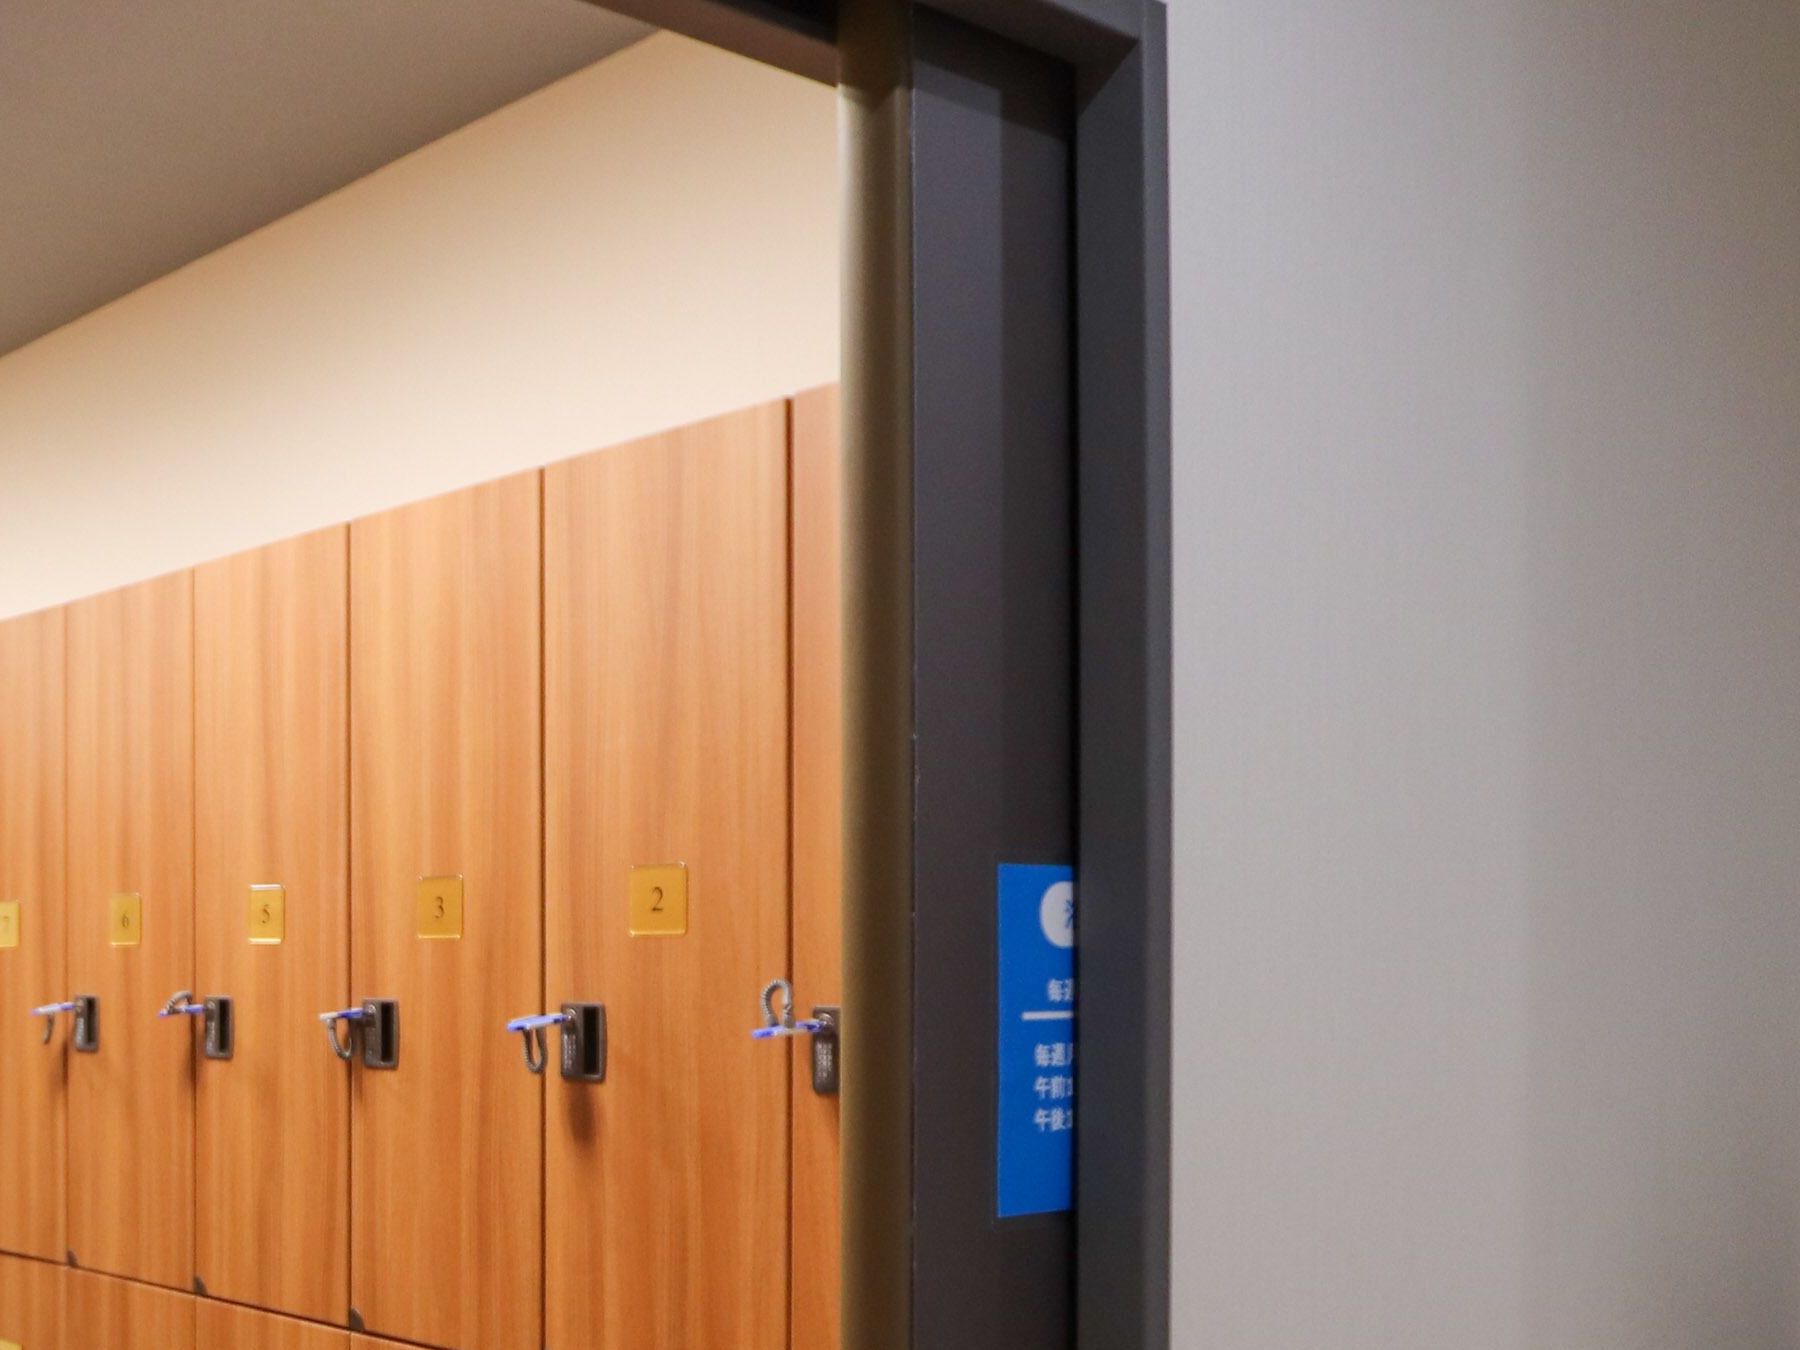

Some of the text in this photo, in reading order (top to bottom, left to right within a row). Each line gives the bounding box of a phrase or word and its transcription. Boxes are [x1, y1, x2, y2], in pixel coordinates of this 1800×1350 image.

[433, 895, 446, 919] 3
[650, 886, 665, 912] 2
[261, 903, 271, 924] 5
